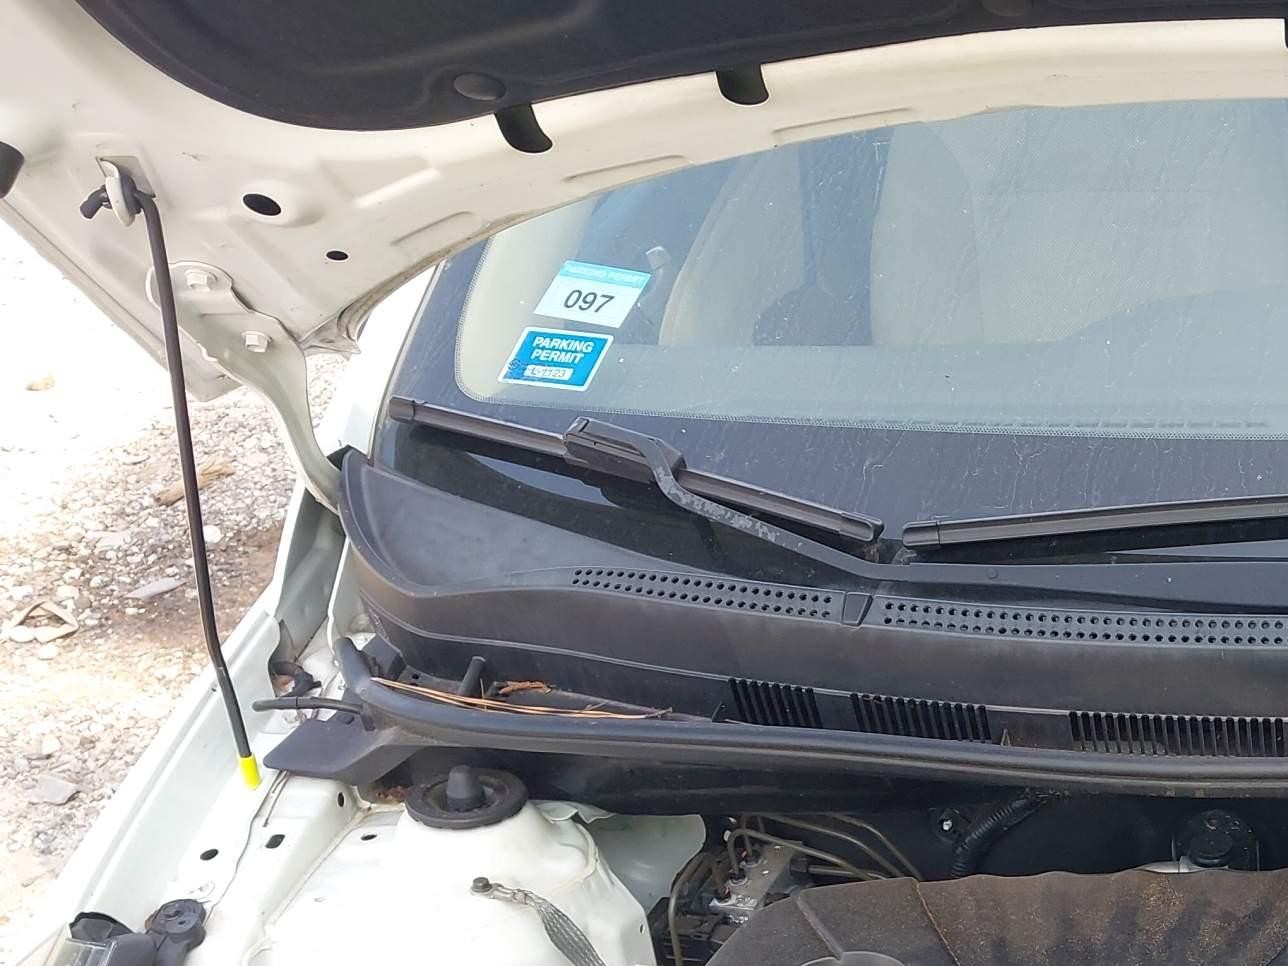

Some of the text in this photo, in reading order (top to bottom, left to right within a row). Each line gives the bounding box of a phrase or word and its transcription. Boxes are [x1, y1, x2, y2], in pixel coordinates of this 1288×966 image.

[563, 289, 615, 313] 097
[532, 336, 595, 353] PARKING
[530, 348, 585, 364] PERMIT
